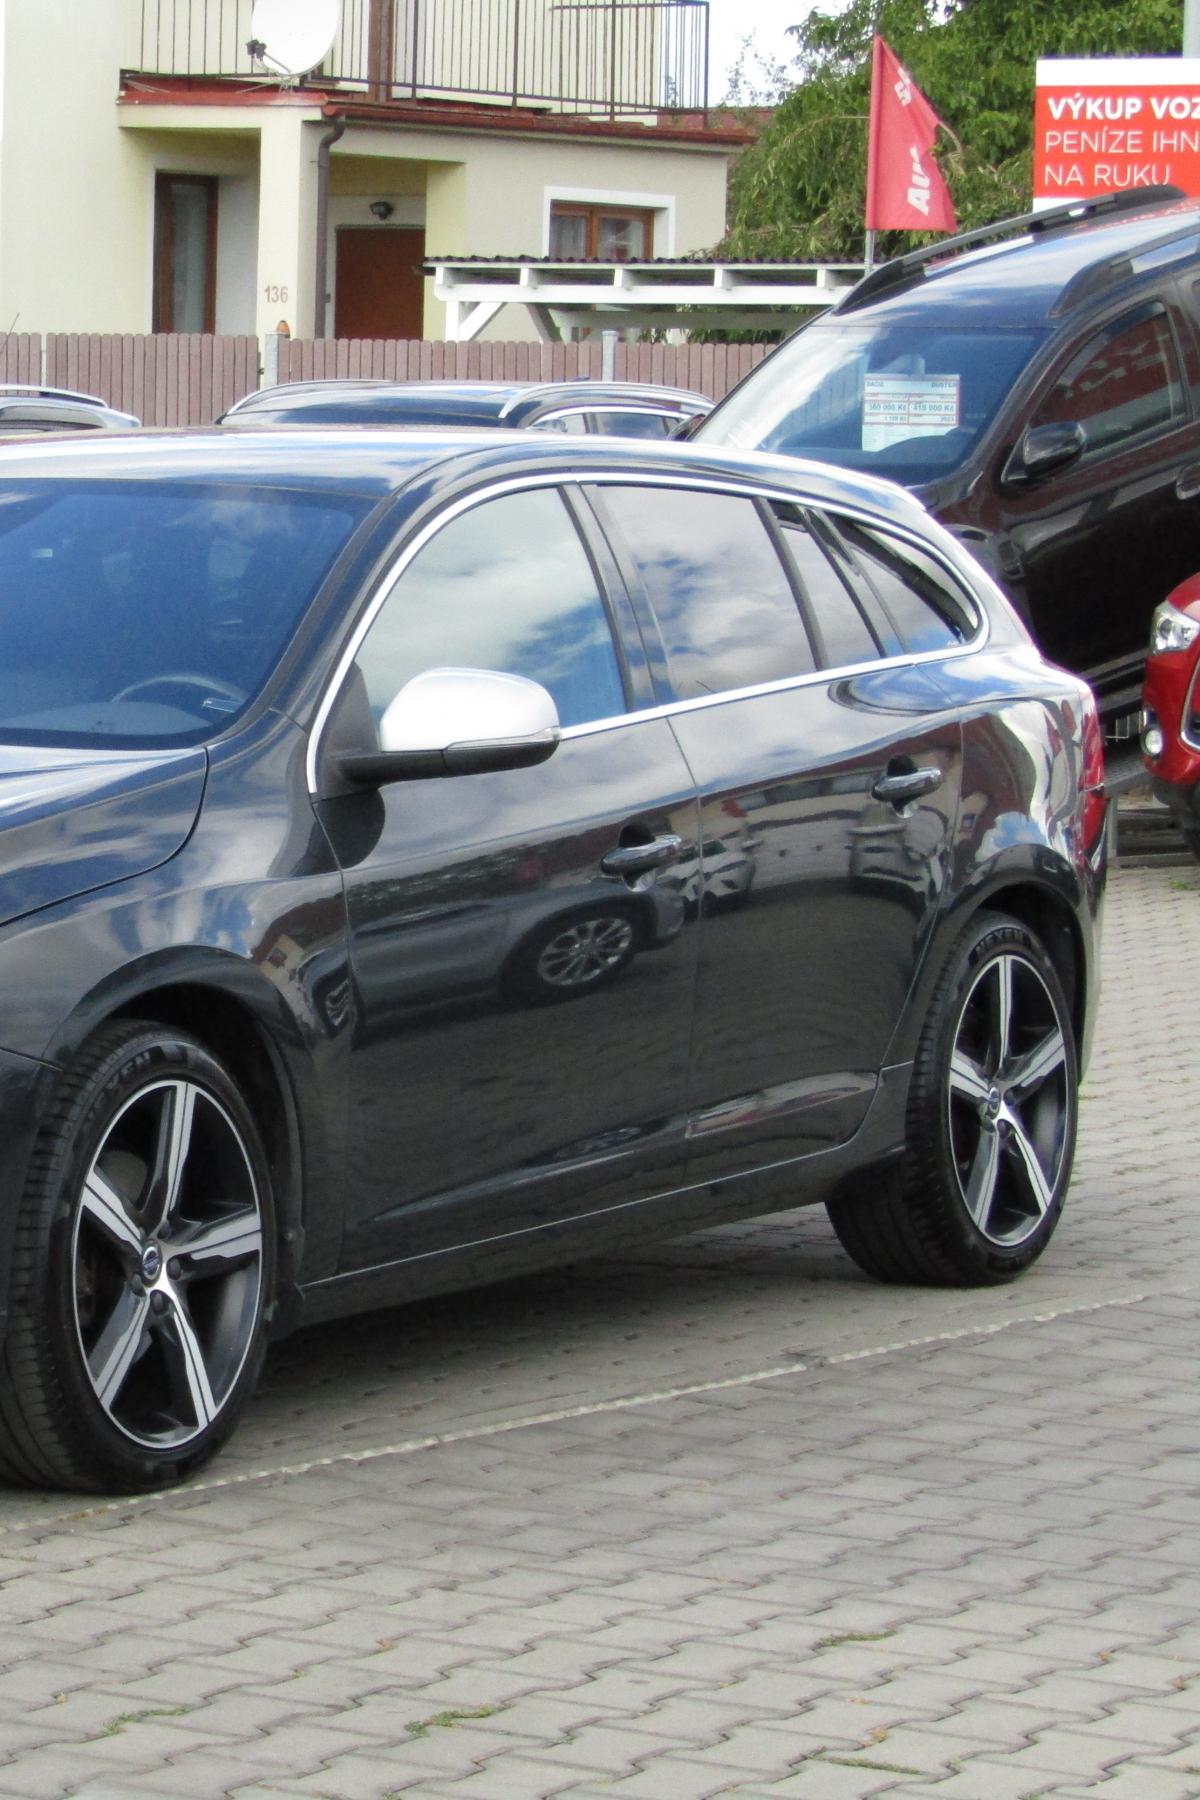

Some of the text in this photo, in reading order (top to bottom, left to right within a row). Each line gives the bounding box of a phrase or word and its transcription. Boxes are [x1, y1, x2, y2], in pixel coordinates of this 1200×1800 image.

[1047, 92, 1142, 120] VÝKUP
[1045, 126, 1200, 153] PENÍZE IHN
[1044, 164, 1171, 187] NA RUKU
[264, 285, 289, 304] 136
